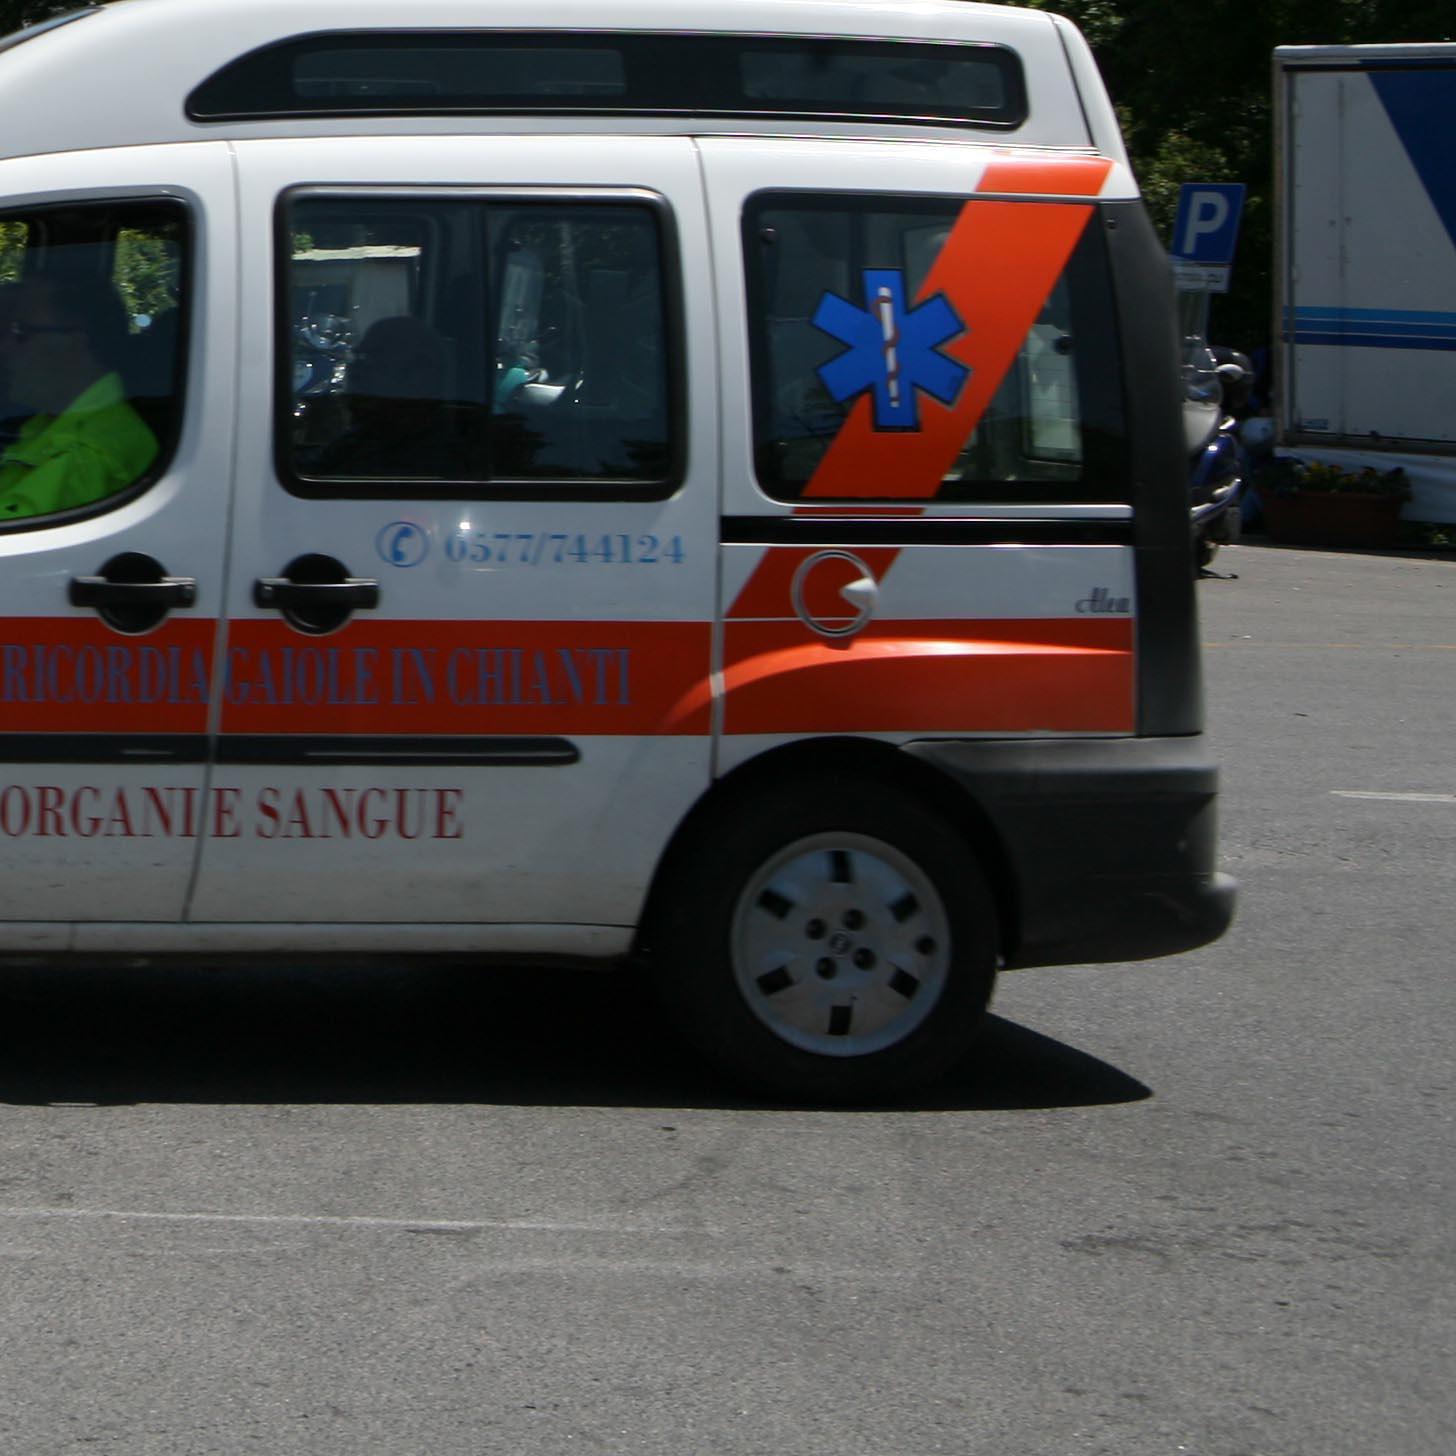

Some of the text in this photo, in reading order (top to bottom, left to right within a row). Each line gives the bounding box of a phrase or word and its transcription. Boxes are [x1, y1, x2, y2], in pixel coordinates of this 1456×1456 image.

[1183, 191, 1230, 255] P
[445, 533, 685, 566] 0577/744124
[220, 646, 380, 705] GAIOLE
[392, 646, 440, 705] IN
[446, 646, 633, 705] CHIANTI
[210, 787, 243, 839] E
[255, 786, 465, 840] SANGUE
